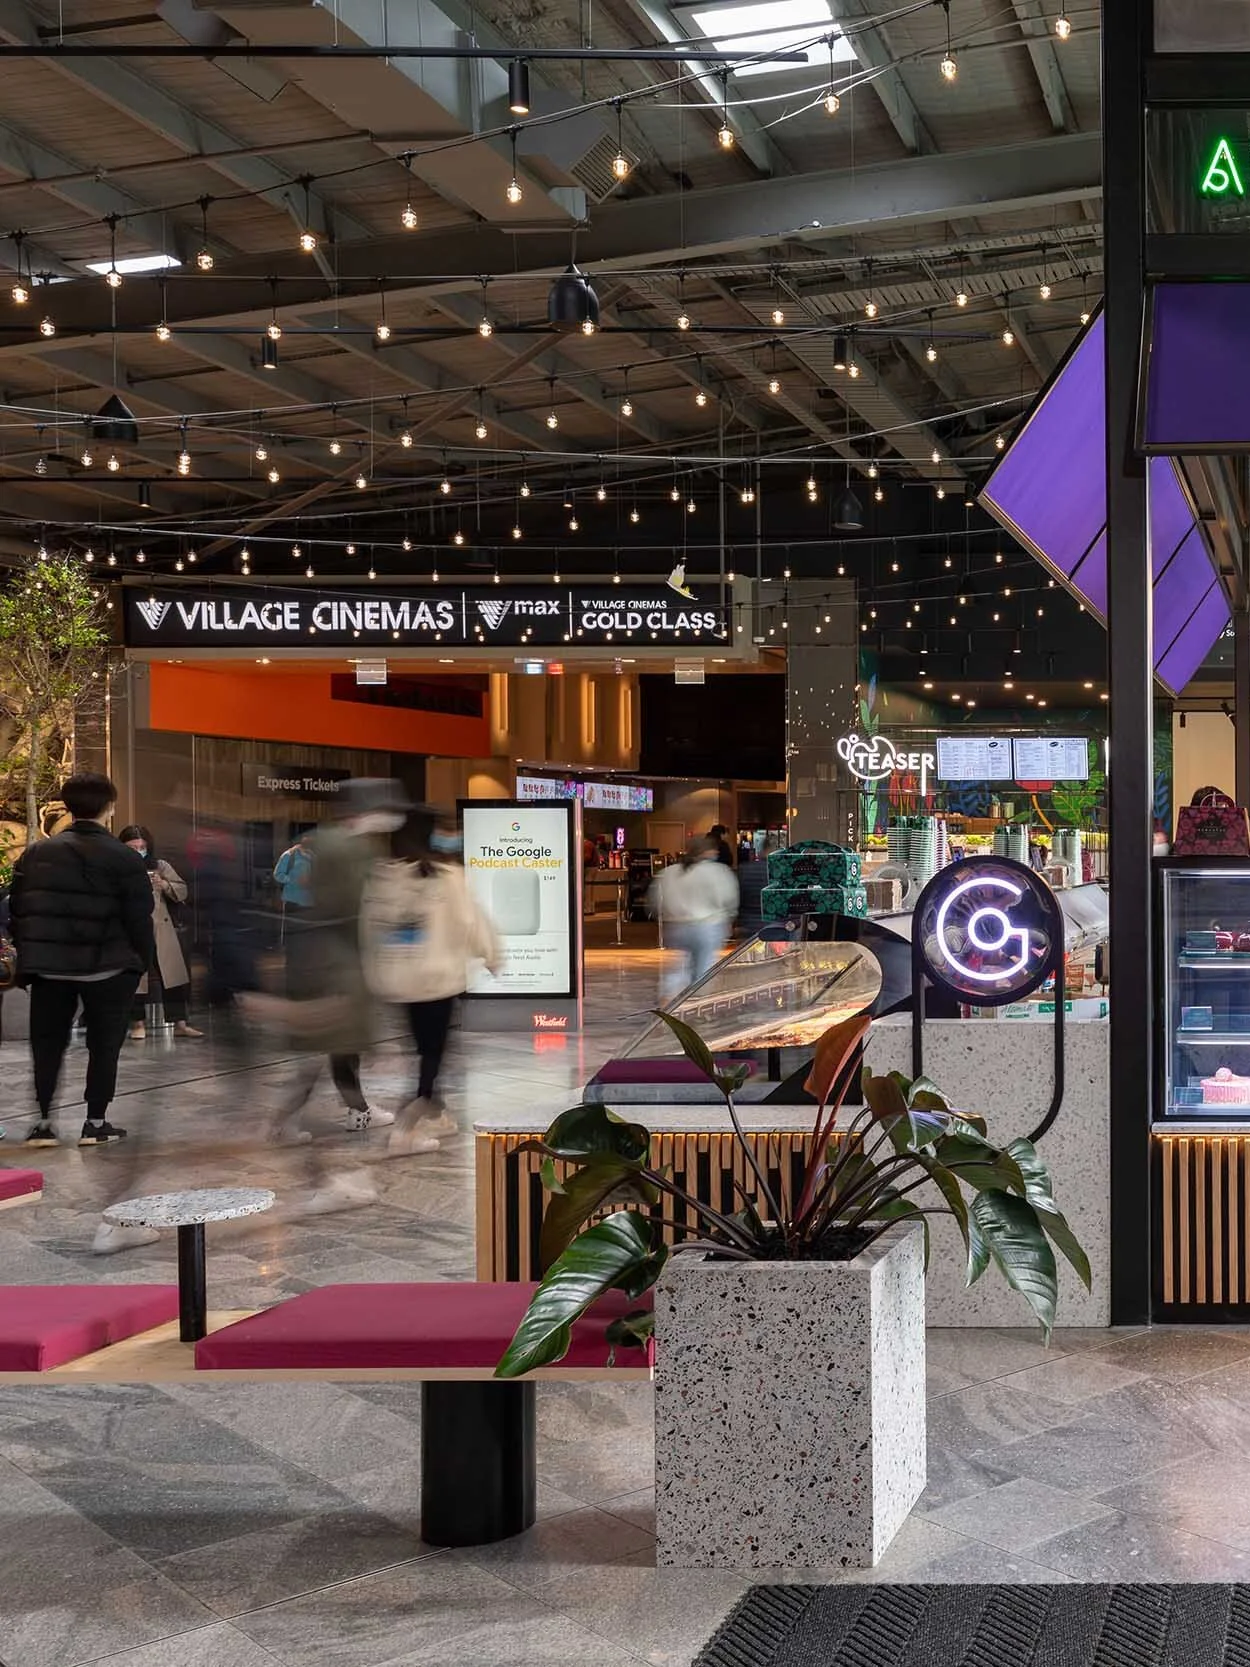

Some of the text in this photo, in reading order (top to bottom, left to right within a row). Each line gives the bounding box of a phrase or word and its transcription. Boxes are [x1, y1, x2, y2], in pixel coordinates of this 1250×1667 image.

[592, 601, 667, 610] VILLAGE CINEMAS
[175, 600, 455, 631] VILLAGE CINEMAS
[581, 612, 716, 630] GOLD CLASS
[257, 775, 340, 792] Express Tickets
[480, 846, 552, 860] The Google
[469, 857, 564, 869] Podcast Caster
